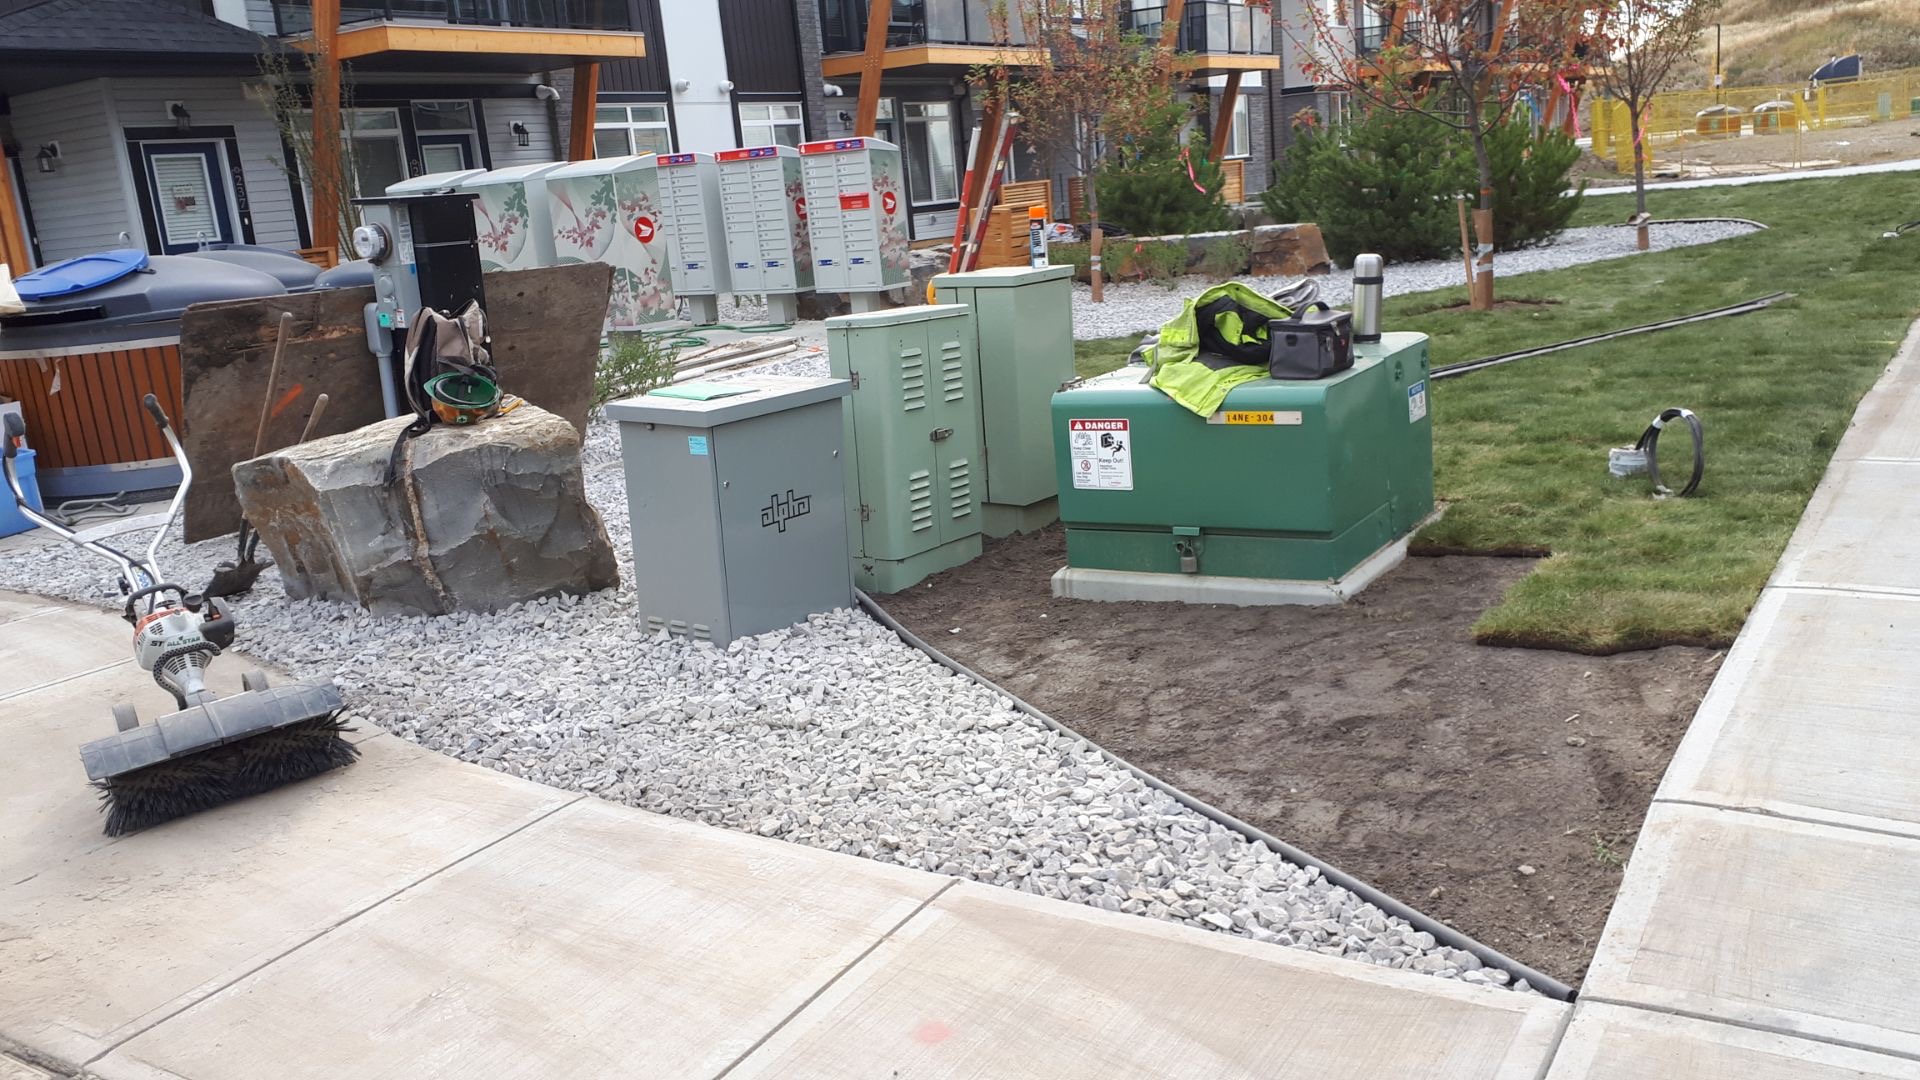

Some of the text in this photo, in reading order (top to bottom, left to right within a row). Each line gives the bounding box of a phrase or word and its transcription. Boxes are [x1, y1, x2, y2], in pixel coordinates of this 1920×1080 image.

[234, 174, 246, 208] 237
[1085, 421, 1124, 430] DANGER
[761, 489, 811, 533] alpha
